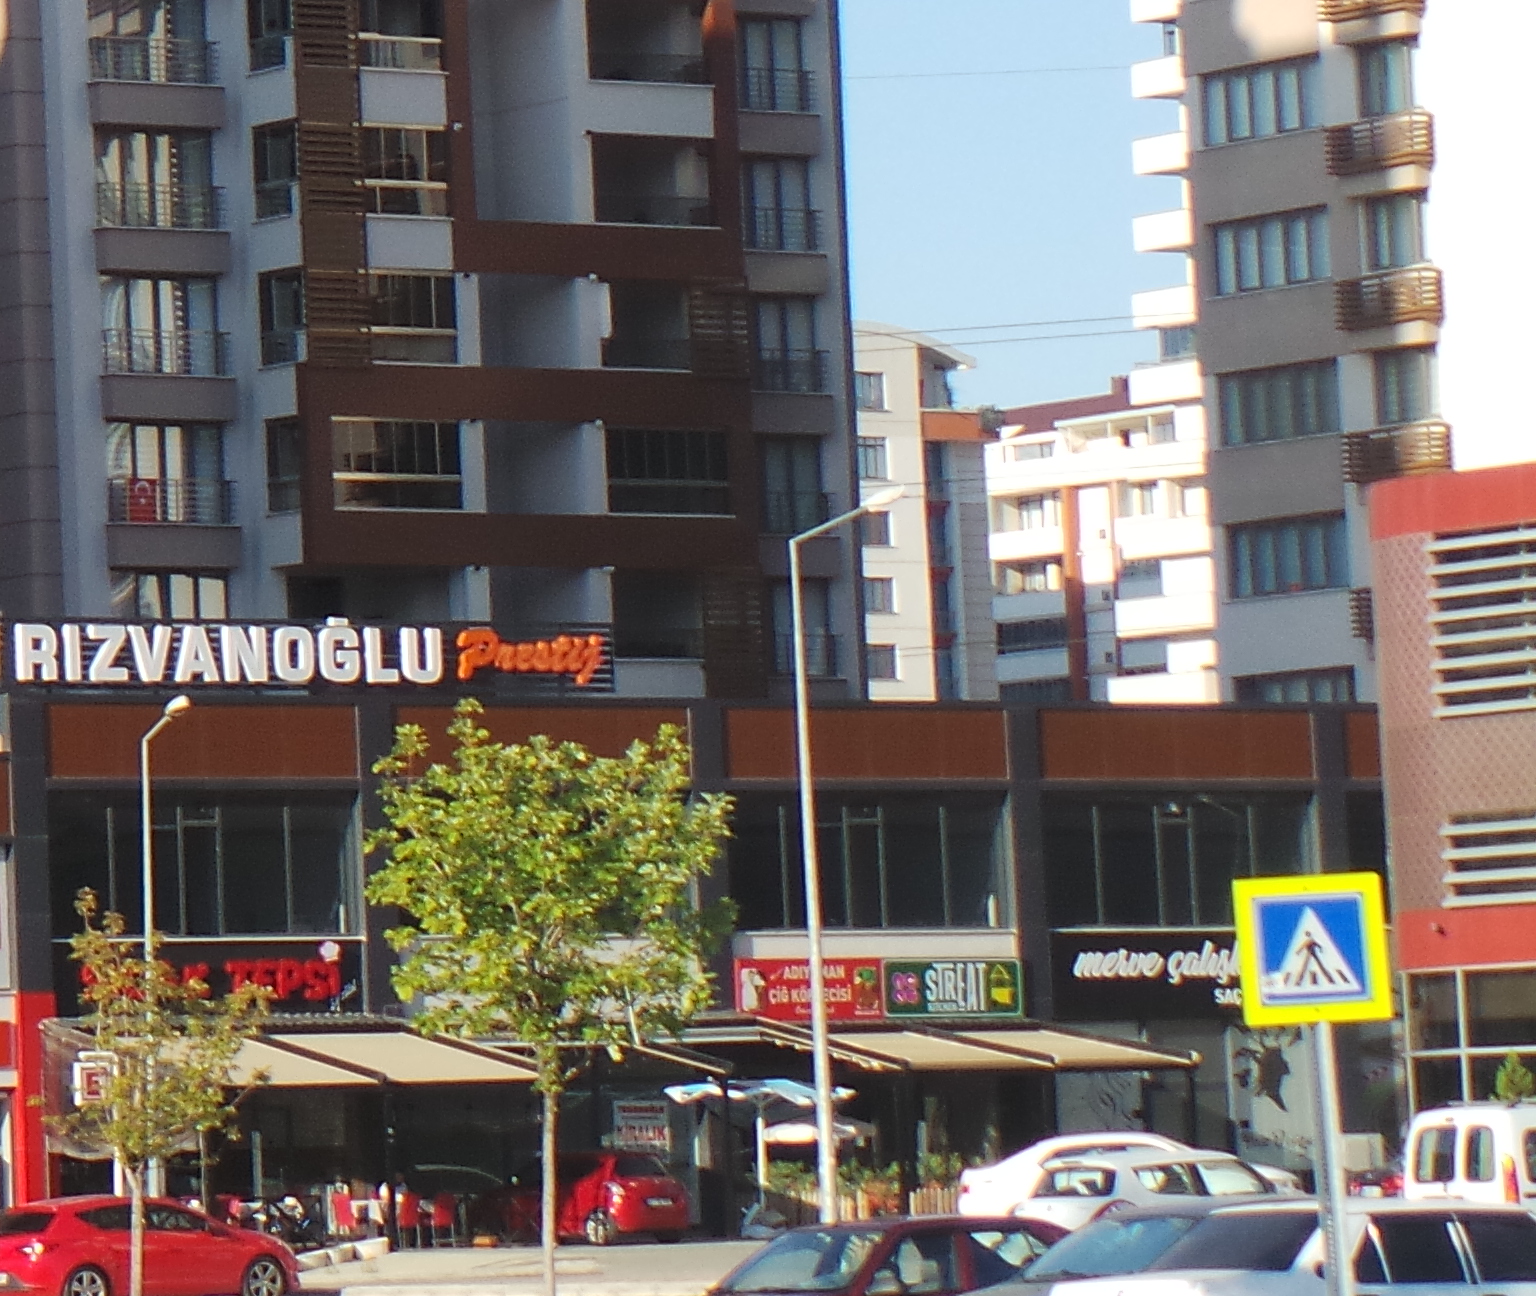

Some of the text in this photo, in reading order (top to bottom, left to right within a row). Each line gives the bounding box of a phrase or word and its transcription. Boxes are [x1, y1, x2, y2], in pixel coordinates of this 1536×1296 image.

[14, 616, 602, 686] RIZVANOĞLU Prestij
[1073, 948, 1164, 978] merve
